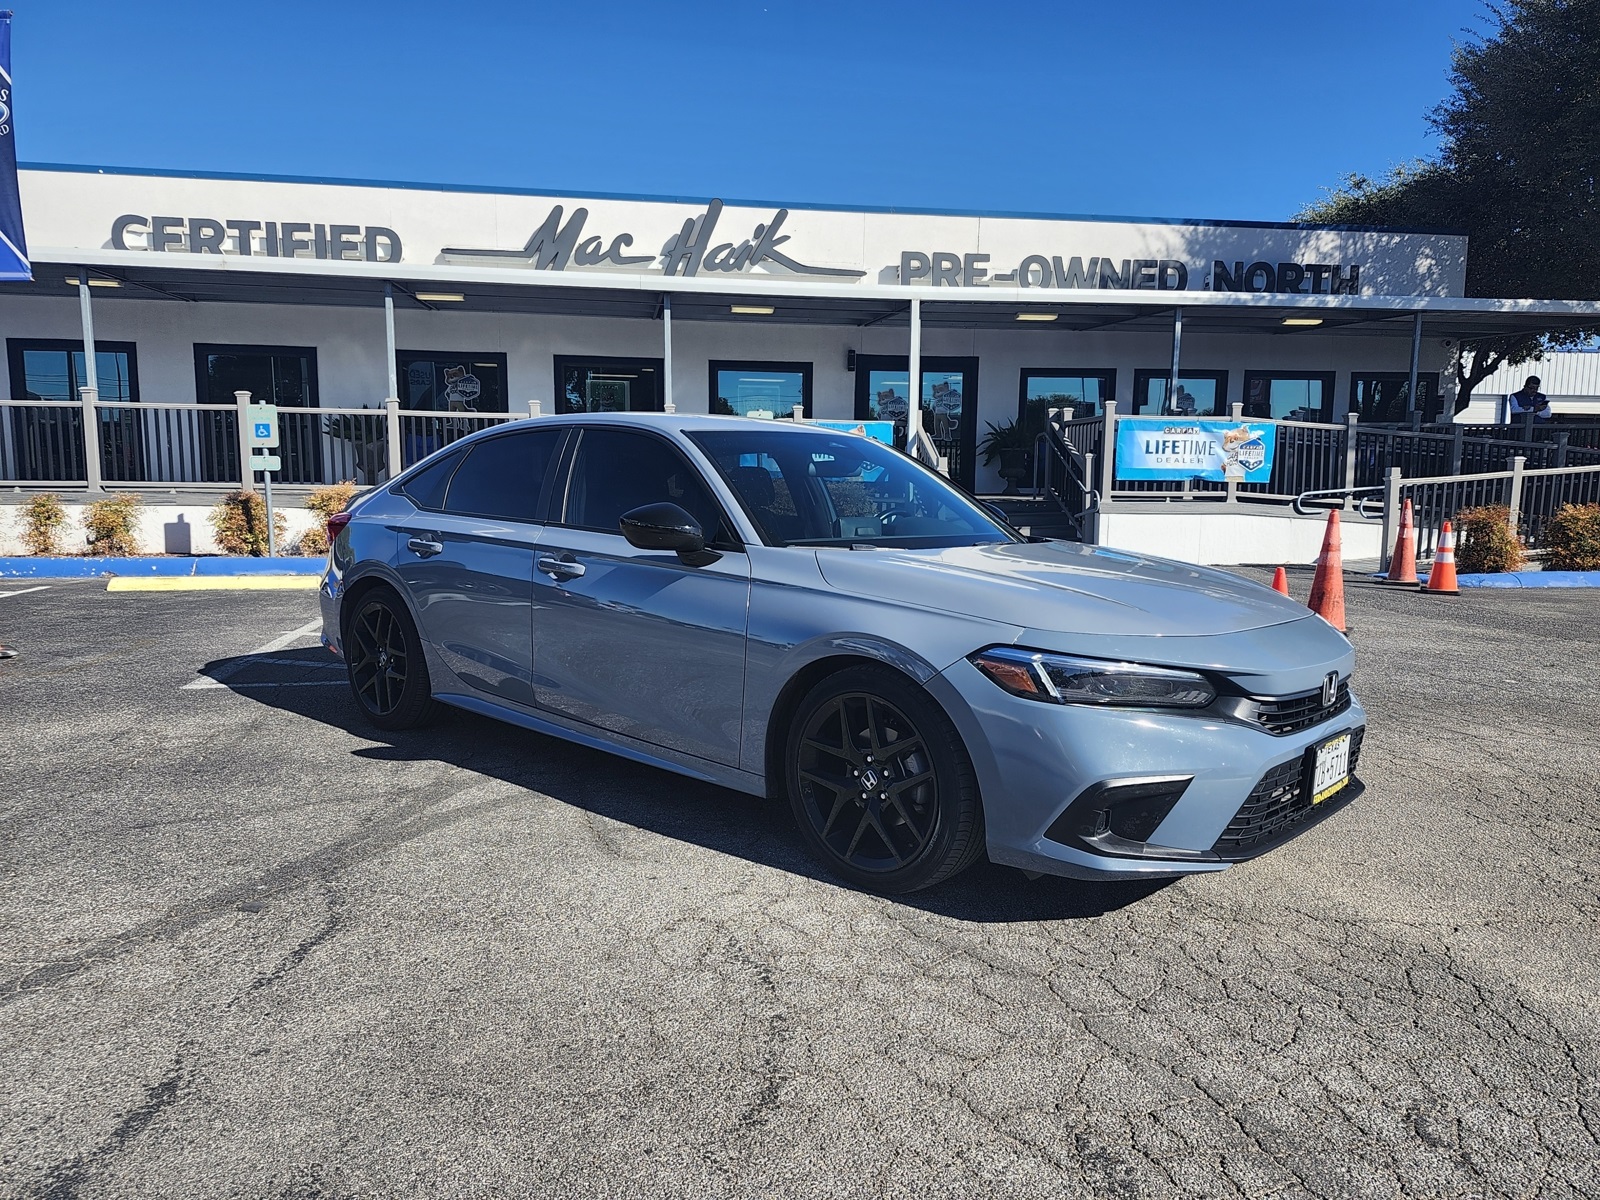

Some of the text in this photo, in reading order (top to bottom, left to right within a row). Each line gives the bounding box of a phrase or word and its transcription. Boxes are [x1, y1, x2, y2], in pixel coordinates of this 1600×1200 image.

[111, 214, 402, 263] CERTIFIED
[441, 198, 867, 277] Mac Haik
[900, 251, 1360, 295] PRE-OWNED NORTH
[1145, 440, 1216, 456] LIFETIME
[1163, 427, 1200, 435] CARFAX
